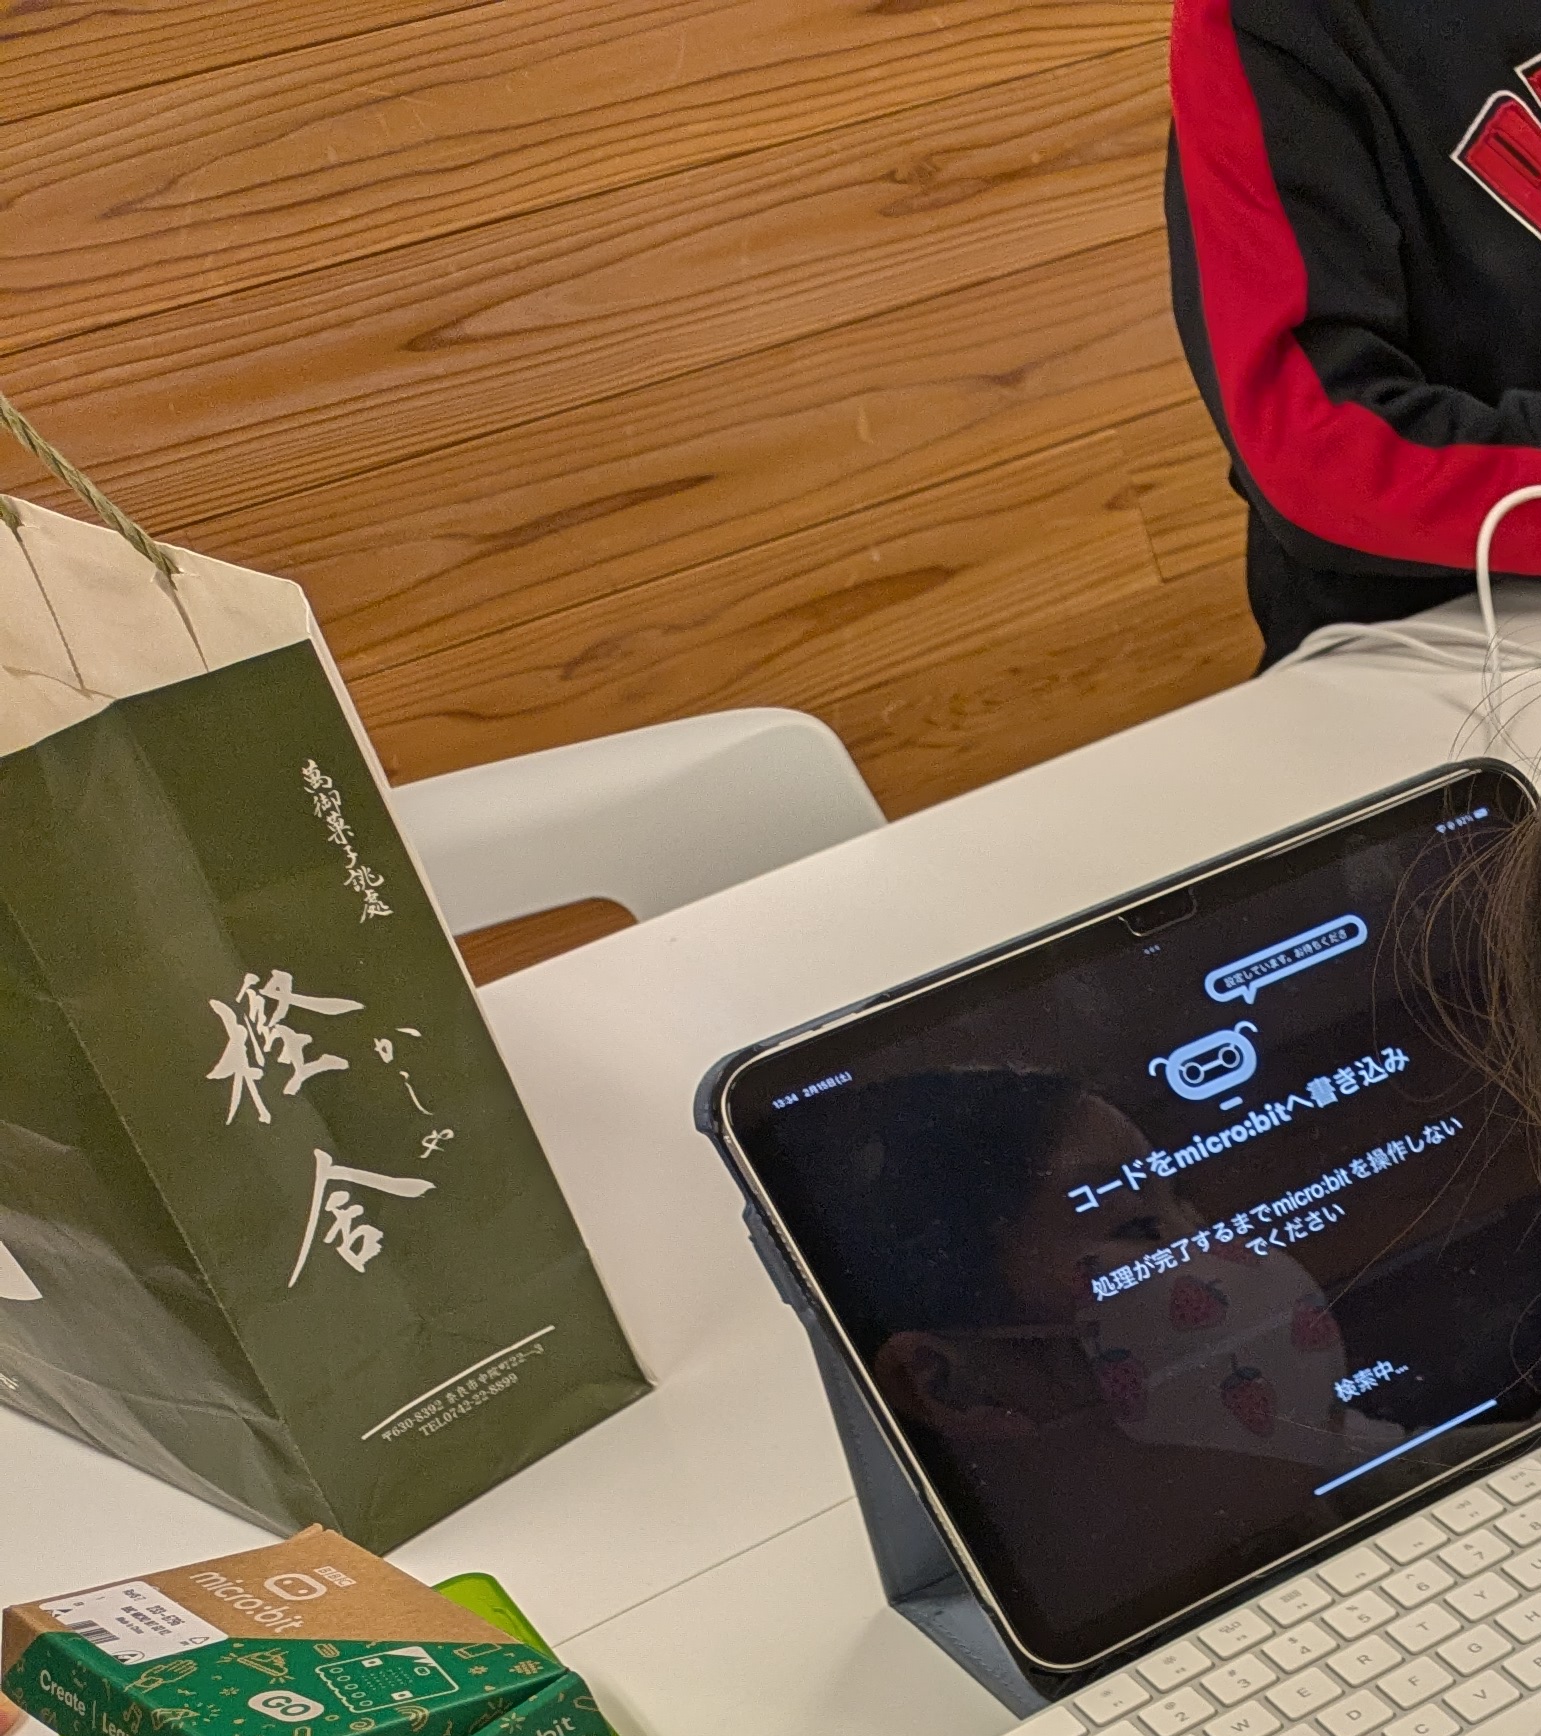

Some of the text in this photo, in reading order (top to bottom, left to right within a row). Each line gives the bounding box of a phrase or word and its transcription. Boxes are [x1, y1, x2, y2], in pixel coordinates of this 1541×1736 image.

[1067, 1046, 1410, 1213] コードをmicro:bitへ書き込み
[1089, 1116, 1464, 1302] 処理が完了するまでmicro:bitを操作しない
[1245, 1202, 1346, 1257] でください
[189, 1571, 304, 1633] micro:bit
[314, 1566, 356, 1588] BBC
[40, 1669, 86, 1716] Create
[261, 1696, 311, 1716] GO
